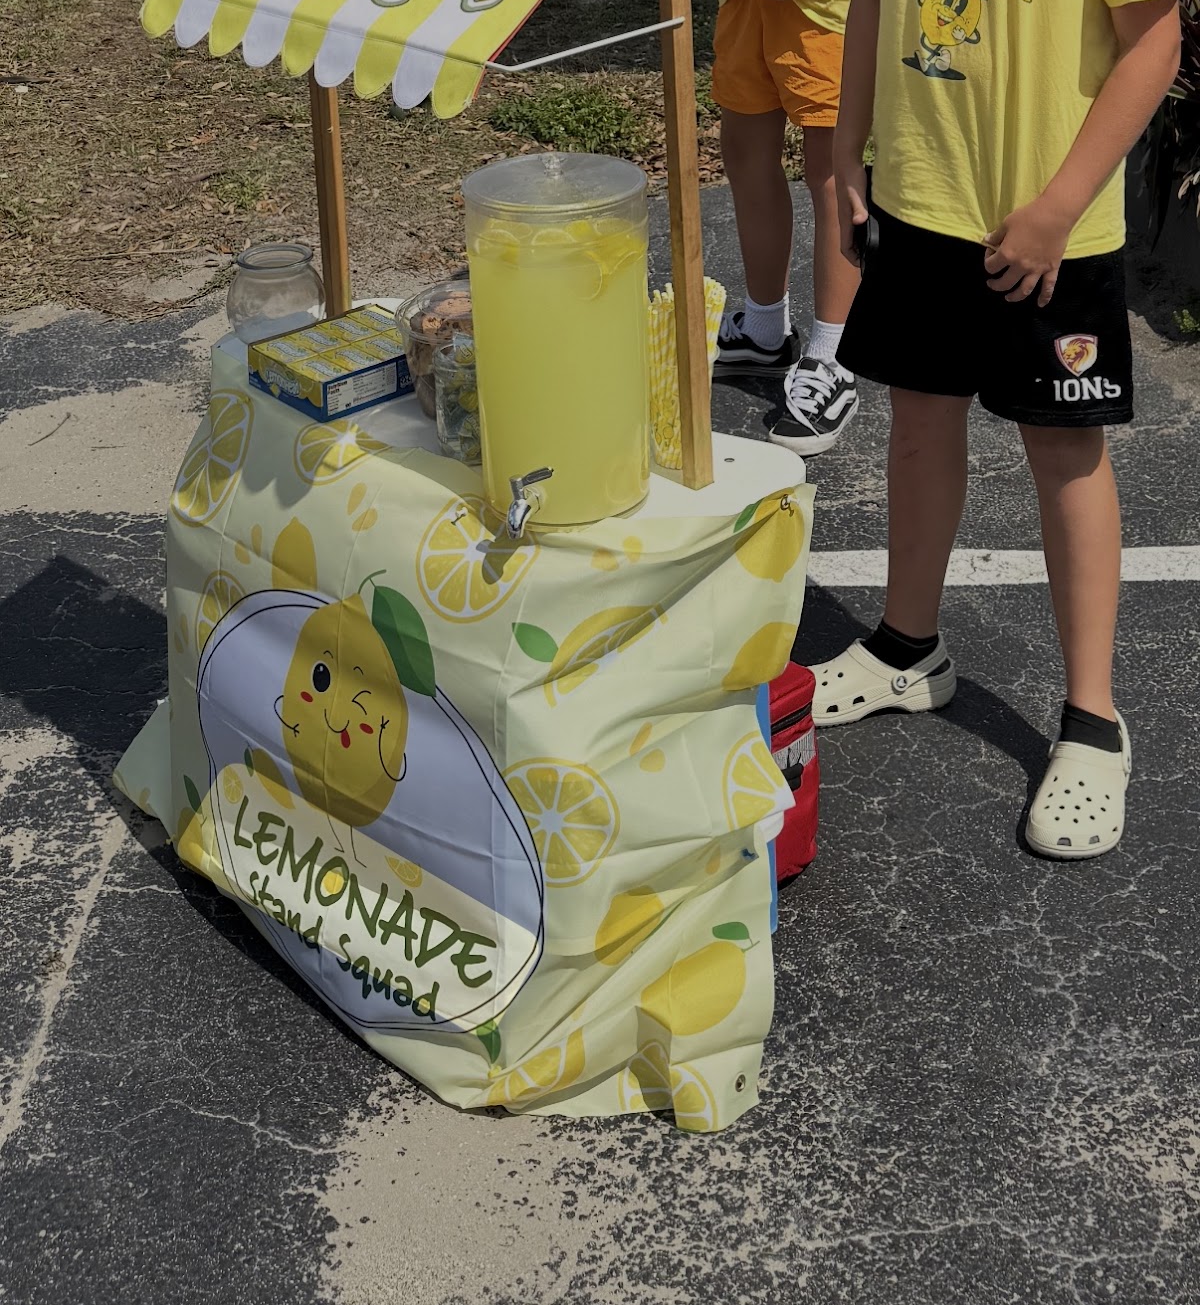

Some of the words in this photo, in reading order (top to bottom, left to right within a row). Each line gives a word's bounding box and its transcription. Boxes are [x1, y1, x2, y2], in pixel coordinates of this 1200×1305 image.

[1036, 376, 1122, 402] IONS
[233, 795, 497, 988] LEMONADE
[250, 871, 323, 954] Stand
